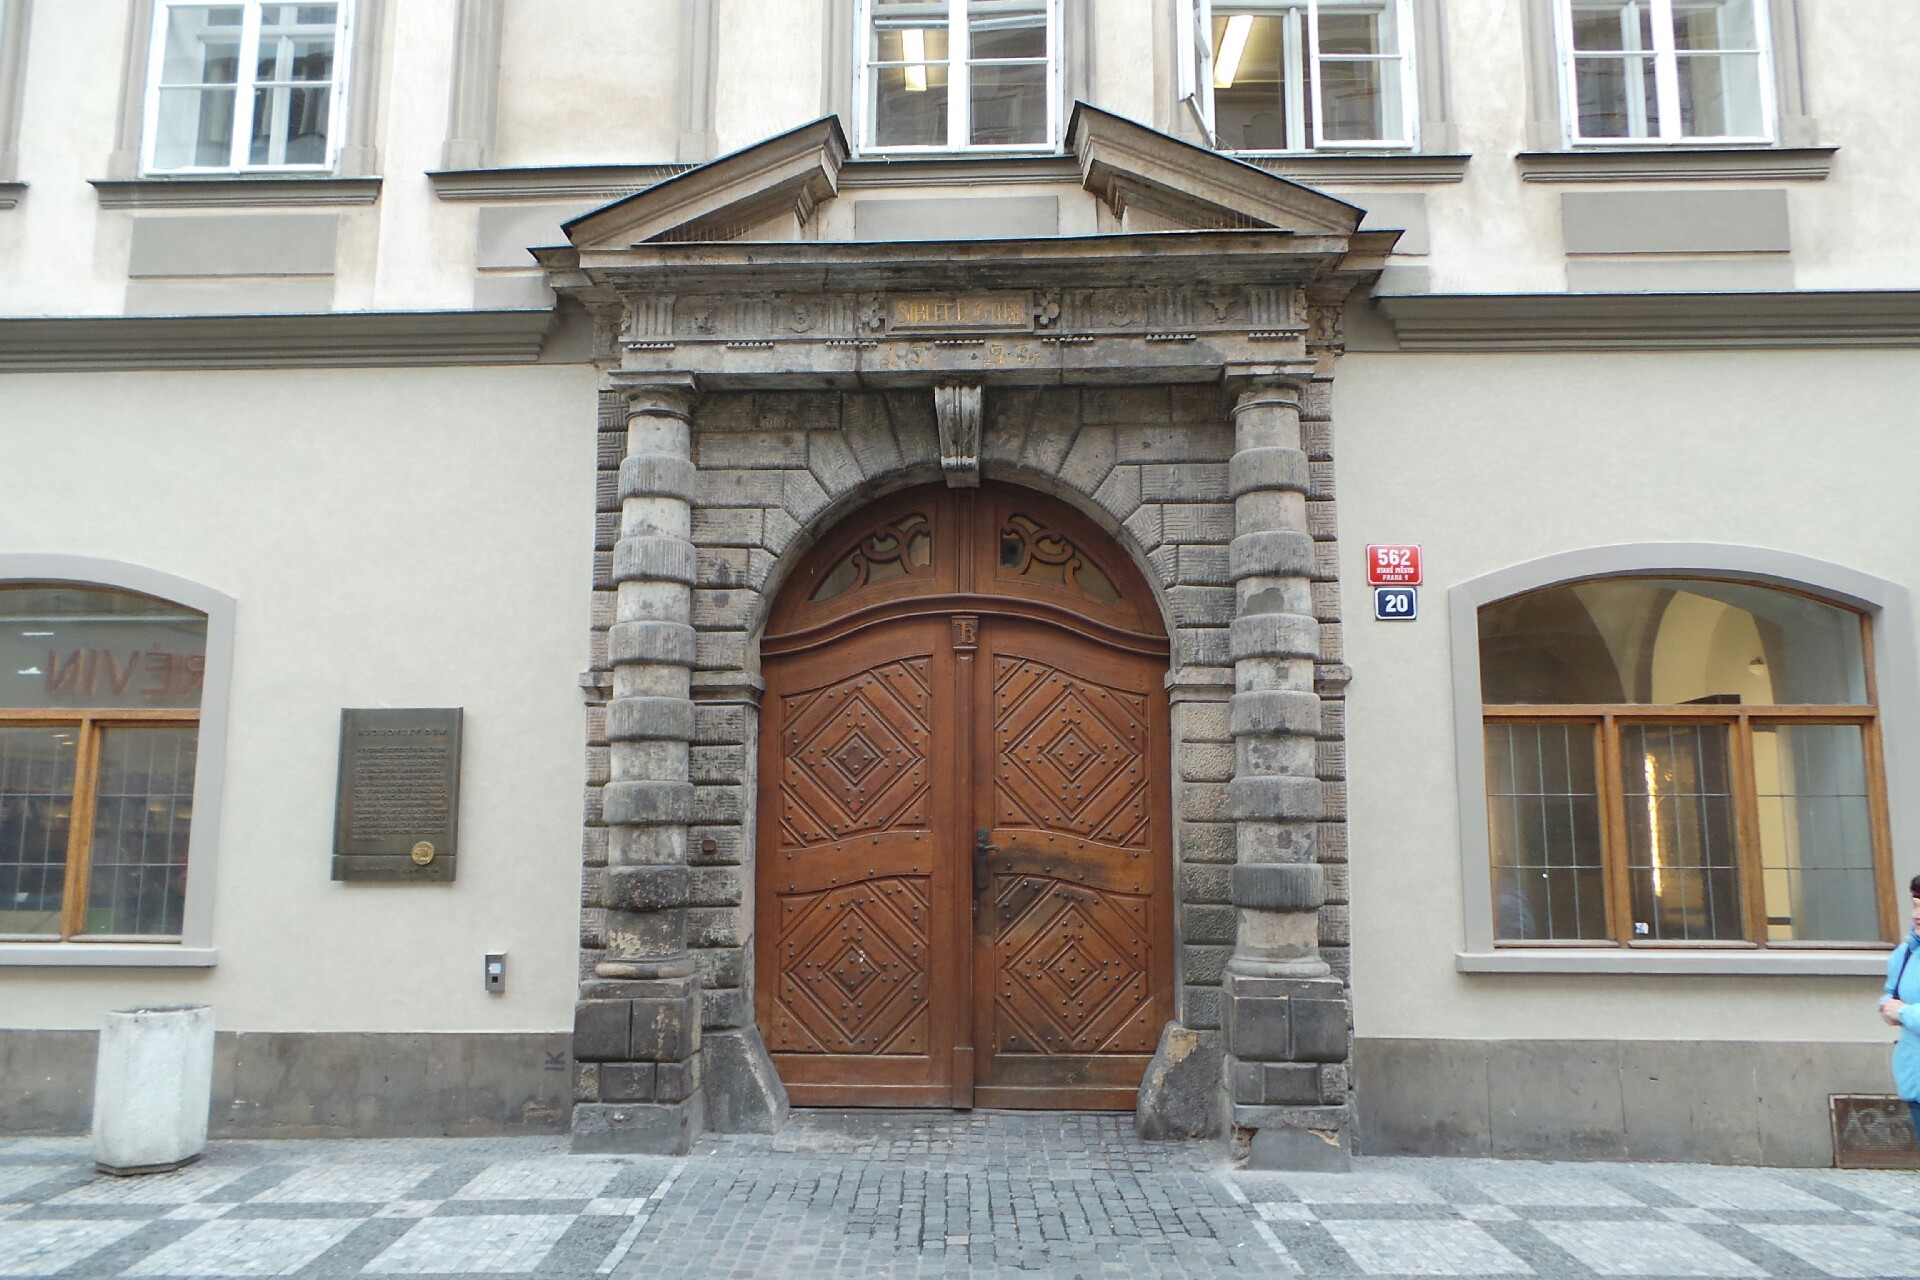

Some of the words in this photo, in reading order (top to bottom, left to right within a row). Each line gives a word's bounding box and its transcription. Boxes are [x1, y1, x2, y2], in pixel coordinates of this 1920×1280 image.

[1377, 549, 1411, 566] 562
[1394, 566, 1415, 574] MĚSTO
[1384, 594, 1409, 613] 20
